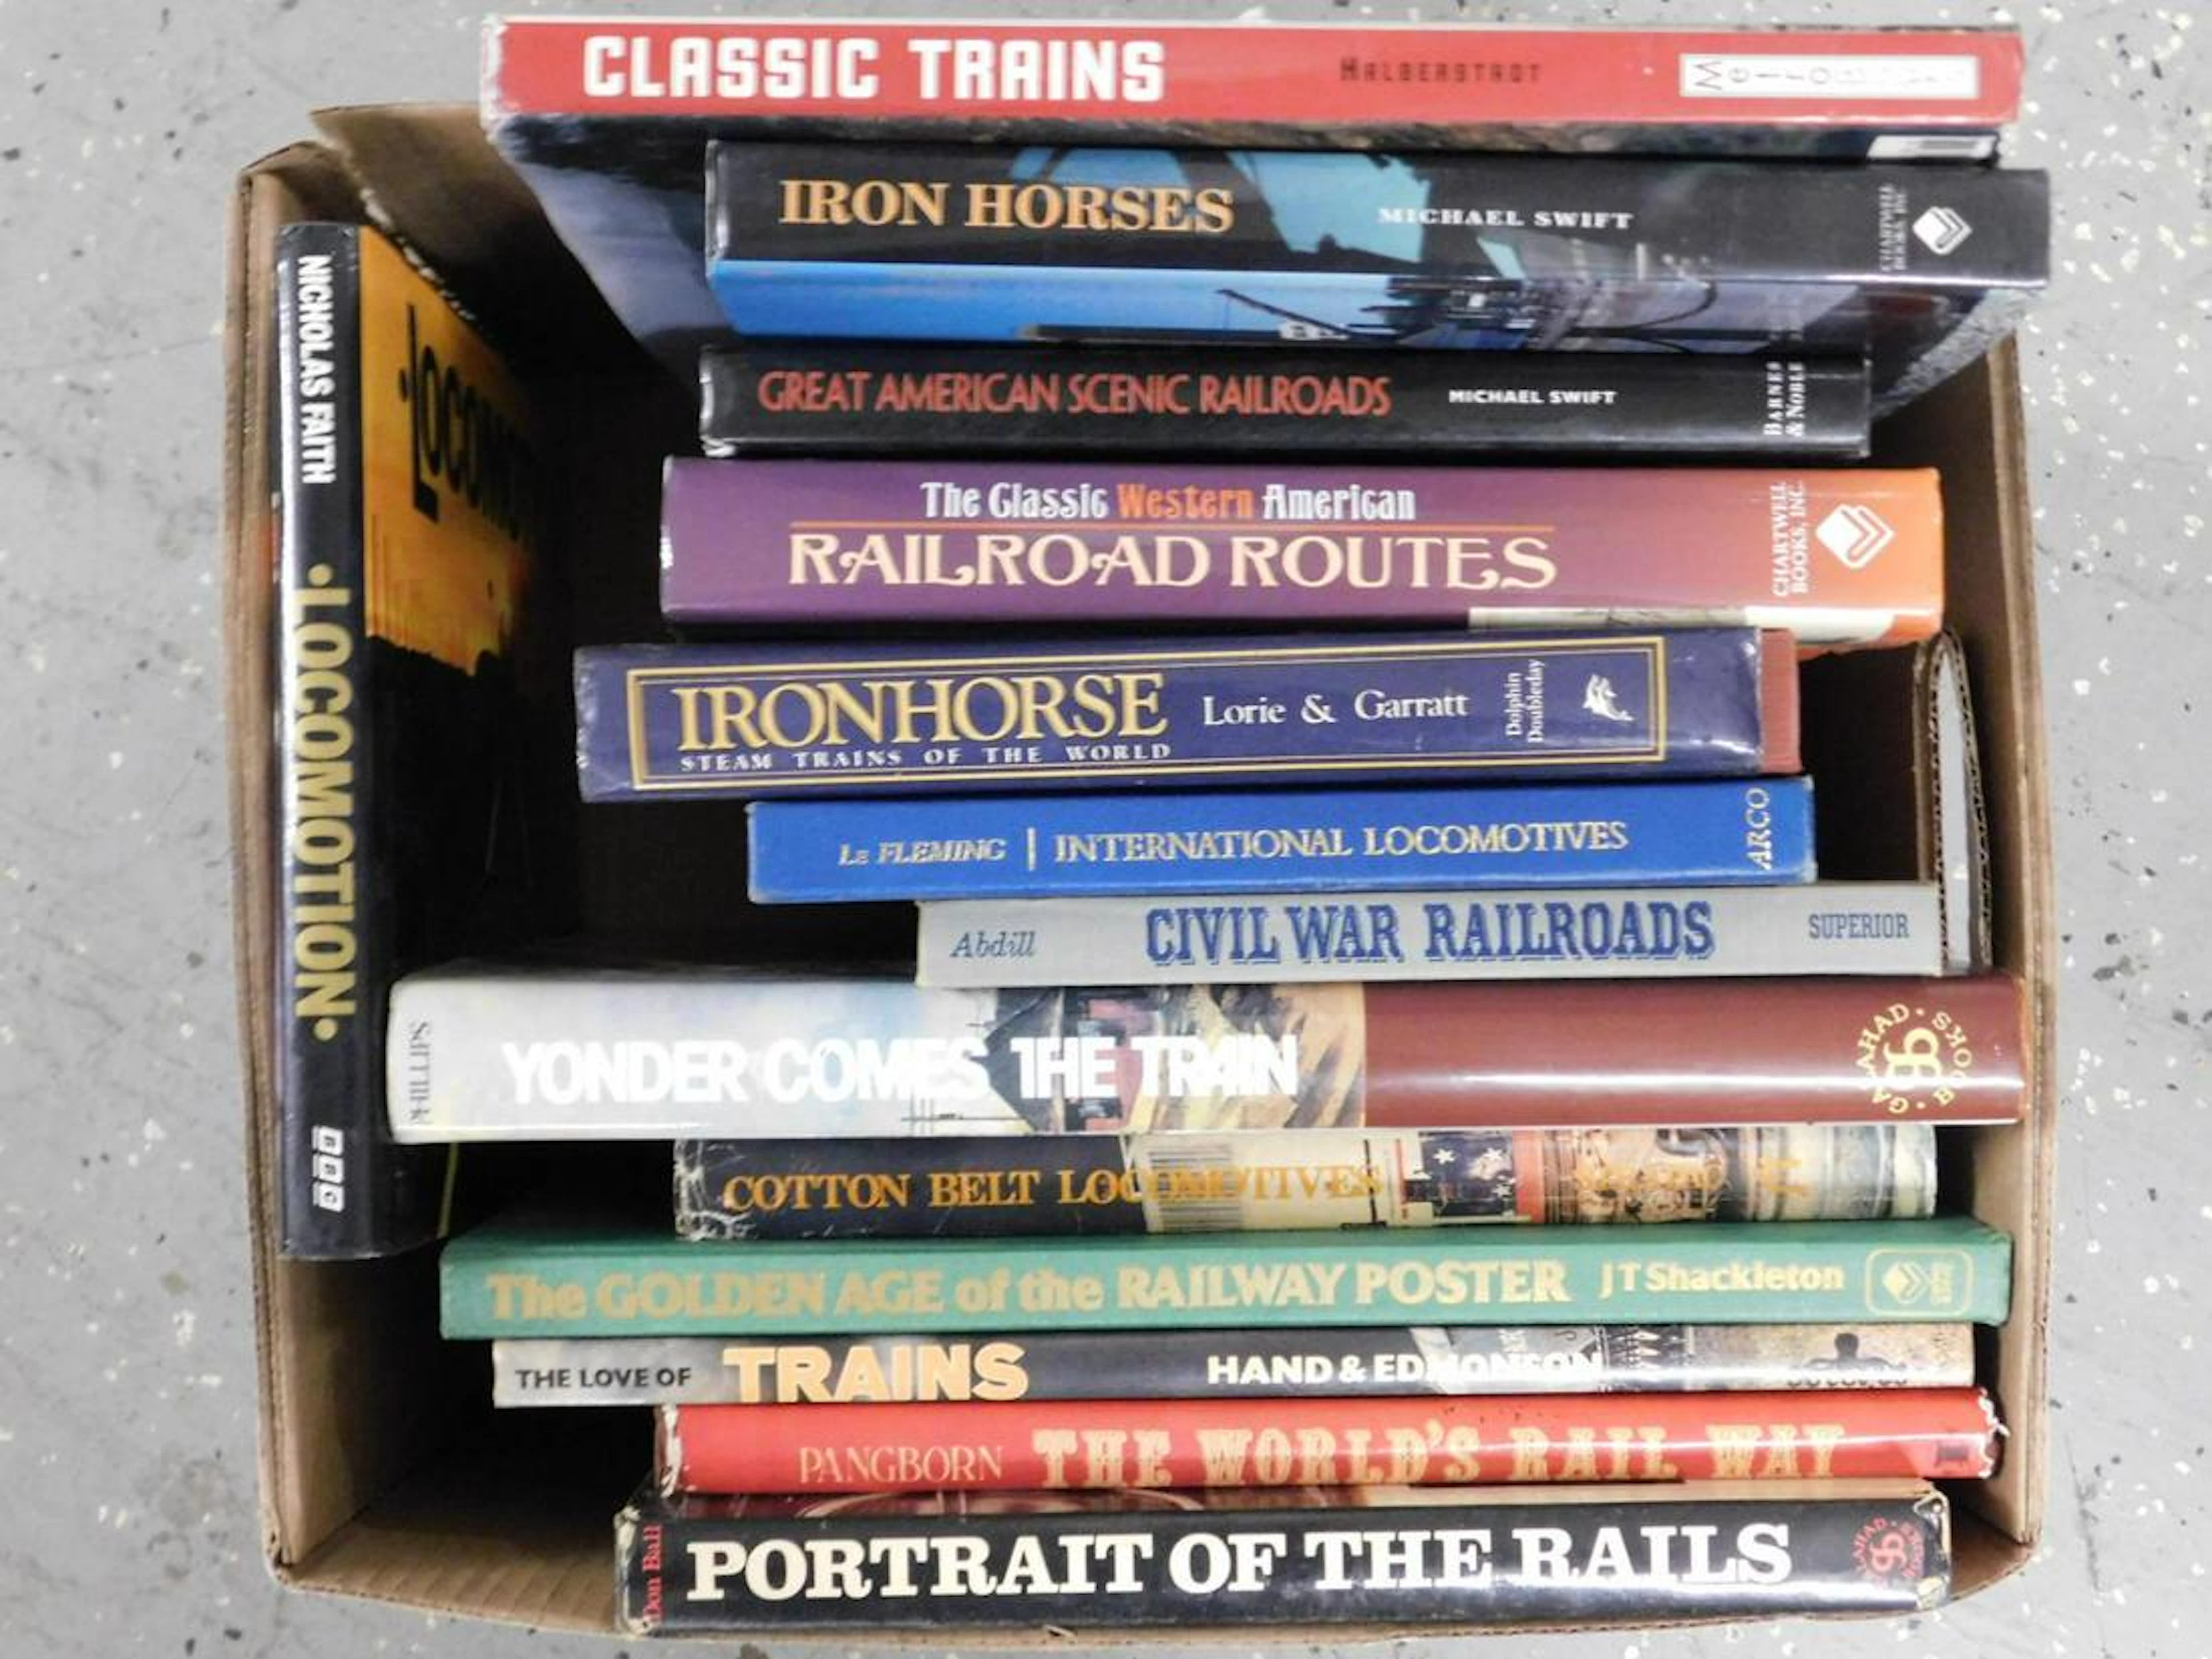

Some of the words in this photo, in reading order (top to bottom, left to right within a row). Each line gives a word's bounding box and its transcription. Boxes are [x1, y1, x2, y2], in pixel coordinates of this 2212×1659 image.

[582, 36, 878, 99] CLASSIC
[908, 38, 1165, 102] TRAINS
[779, 179, 950, 226] IRON
[965, 181, 1234, 233] HORSES
[1378, 206, 1525, 228] MICHAEL
[1534, 209, 1634, 230] SWIFT
[297, 254, 335, 399] NICHOLAS
[757, 371, 872, 412] GREAT
[874, 372, 1059, 414] AMERICAN
[1068, 373, 1190, 415] SCENIC
[1198, 374, 1391, 416] RAILROADS
[1448, 388, 1545, 405] MICHAEL
[1548, 389, 1617, 406] SWIFT
[301, 404, 338, 485] FAITH
[920, 482, 980, 517] The
[989, 482, 1109, 518] Classic
[1116, 483, 1255, 519] Western
[1262, 484, 1416, 520] American
[789, 533, 1211, 586] RAILROAD
[1229, 536, 1557, 590] ROUTES
[671, 673, 1169, 752] IRONHORSE
[1203, 696, 1286, 726] Lorie
[1301, 694, 1337, 724] &
[1354, 689, 1469, 721] Garratt
[1503, 672, 1525, 736] Dolphin
[1525, 658, 1545, 743] Doubleday
[680, 752, 773, 772] STEAM
[792, 749, 902, 768] TRAINS
[924, 747, 964, 766] OF
[981, 745, 1043, 763] THE
[1065, 743, 1172, 760] WORLD
[291, 588, 355, 1017] LOCOMOTION
[877, 838, 1006, 865] FLEMING
[1055, 828, 1354, 863] INTERNATIONAL
[1363, 821, 1628, 856] LOCOMOTIVES
[1744, 787, 1773, 870] ARCO
[950, 931, 1036, 959] Abdill
[1145, 904, 1281, 967] CIVIL
[1284, 903, 1404, 964] WAR
[1423, 900, 1717, 963] RAILROADS
[1808, 912, 1910, 940] SUPERIOR
[501, 1039, 748, 1105] YONDER
[761, 1038, 990, 1104] COMES
[1010, 1035, 1118, 1098] THE
[1128, 1033, 1298, 1098] TRAIN
[722, 1173, 912, 1210] COTTON
[926, 1170, 1041, 1208] BELT
[486, 1272, 586, 1320] The
[596, 1272, 824, 1320] GOLDEN
[835, 1271, 945, 1316] AGE
[956, 1266, 1015, 1313] of
[1018, 1268, 1103, 1312] the
[1118, 1263, 1347, 1310] RAILWAY
[1356, 1259, 1571, 1305] POSTER
[1646, 1260, 1846, 1291] Shackleton
[514, 1368, 571, 1390] THE
[579, 1368, 650, 1389] LOVE
[658, 1366, 692, 1387] OF
[721, 1342, 1030, 1403] TRAINS
[1206, 1353, 1337, 1385] HAND
[1340, 1354, 1368, 1384] &
[799, 1445, 1003, 1484] PANGBORN
[1032, 1429, 1172, 1487] THE
[1195, 1418, 1482, 1484] WORLD'S
[1507, 1426, 1680, 1481] RAIL
[1705, 1424, 1844, 1479] WAY
[641, 1522, 662, 1571] Ball
[686, 1532, 1153, 1601] PORTRAIT
[1168, 1532, 1286, 1594] OF
[1304, 1527, 1493, 1590] THE
[1512, 1522, 1793, 1585] RAILS
[642, 1576, 662, 1626] Don
